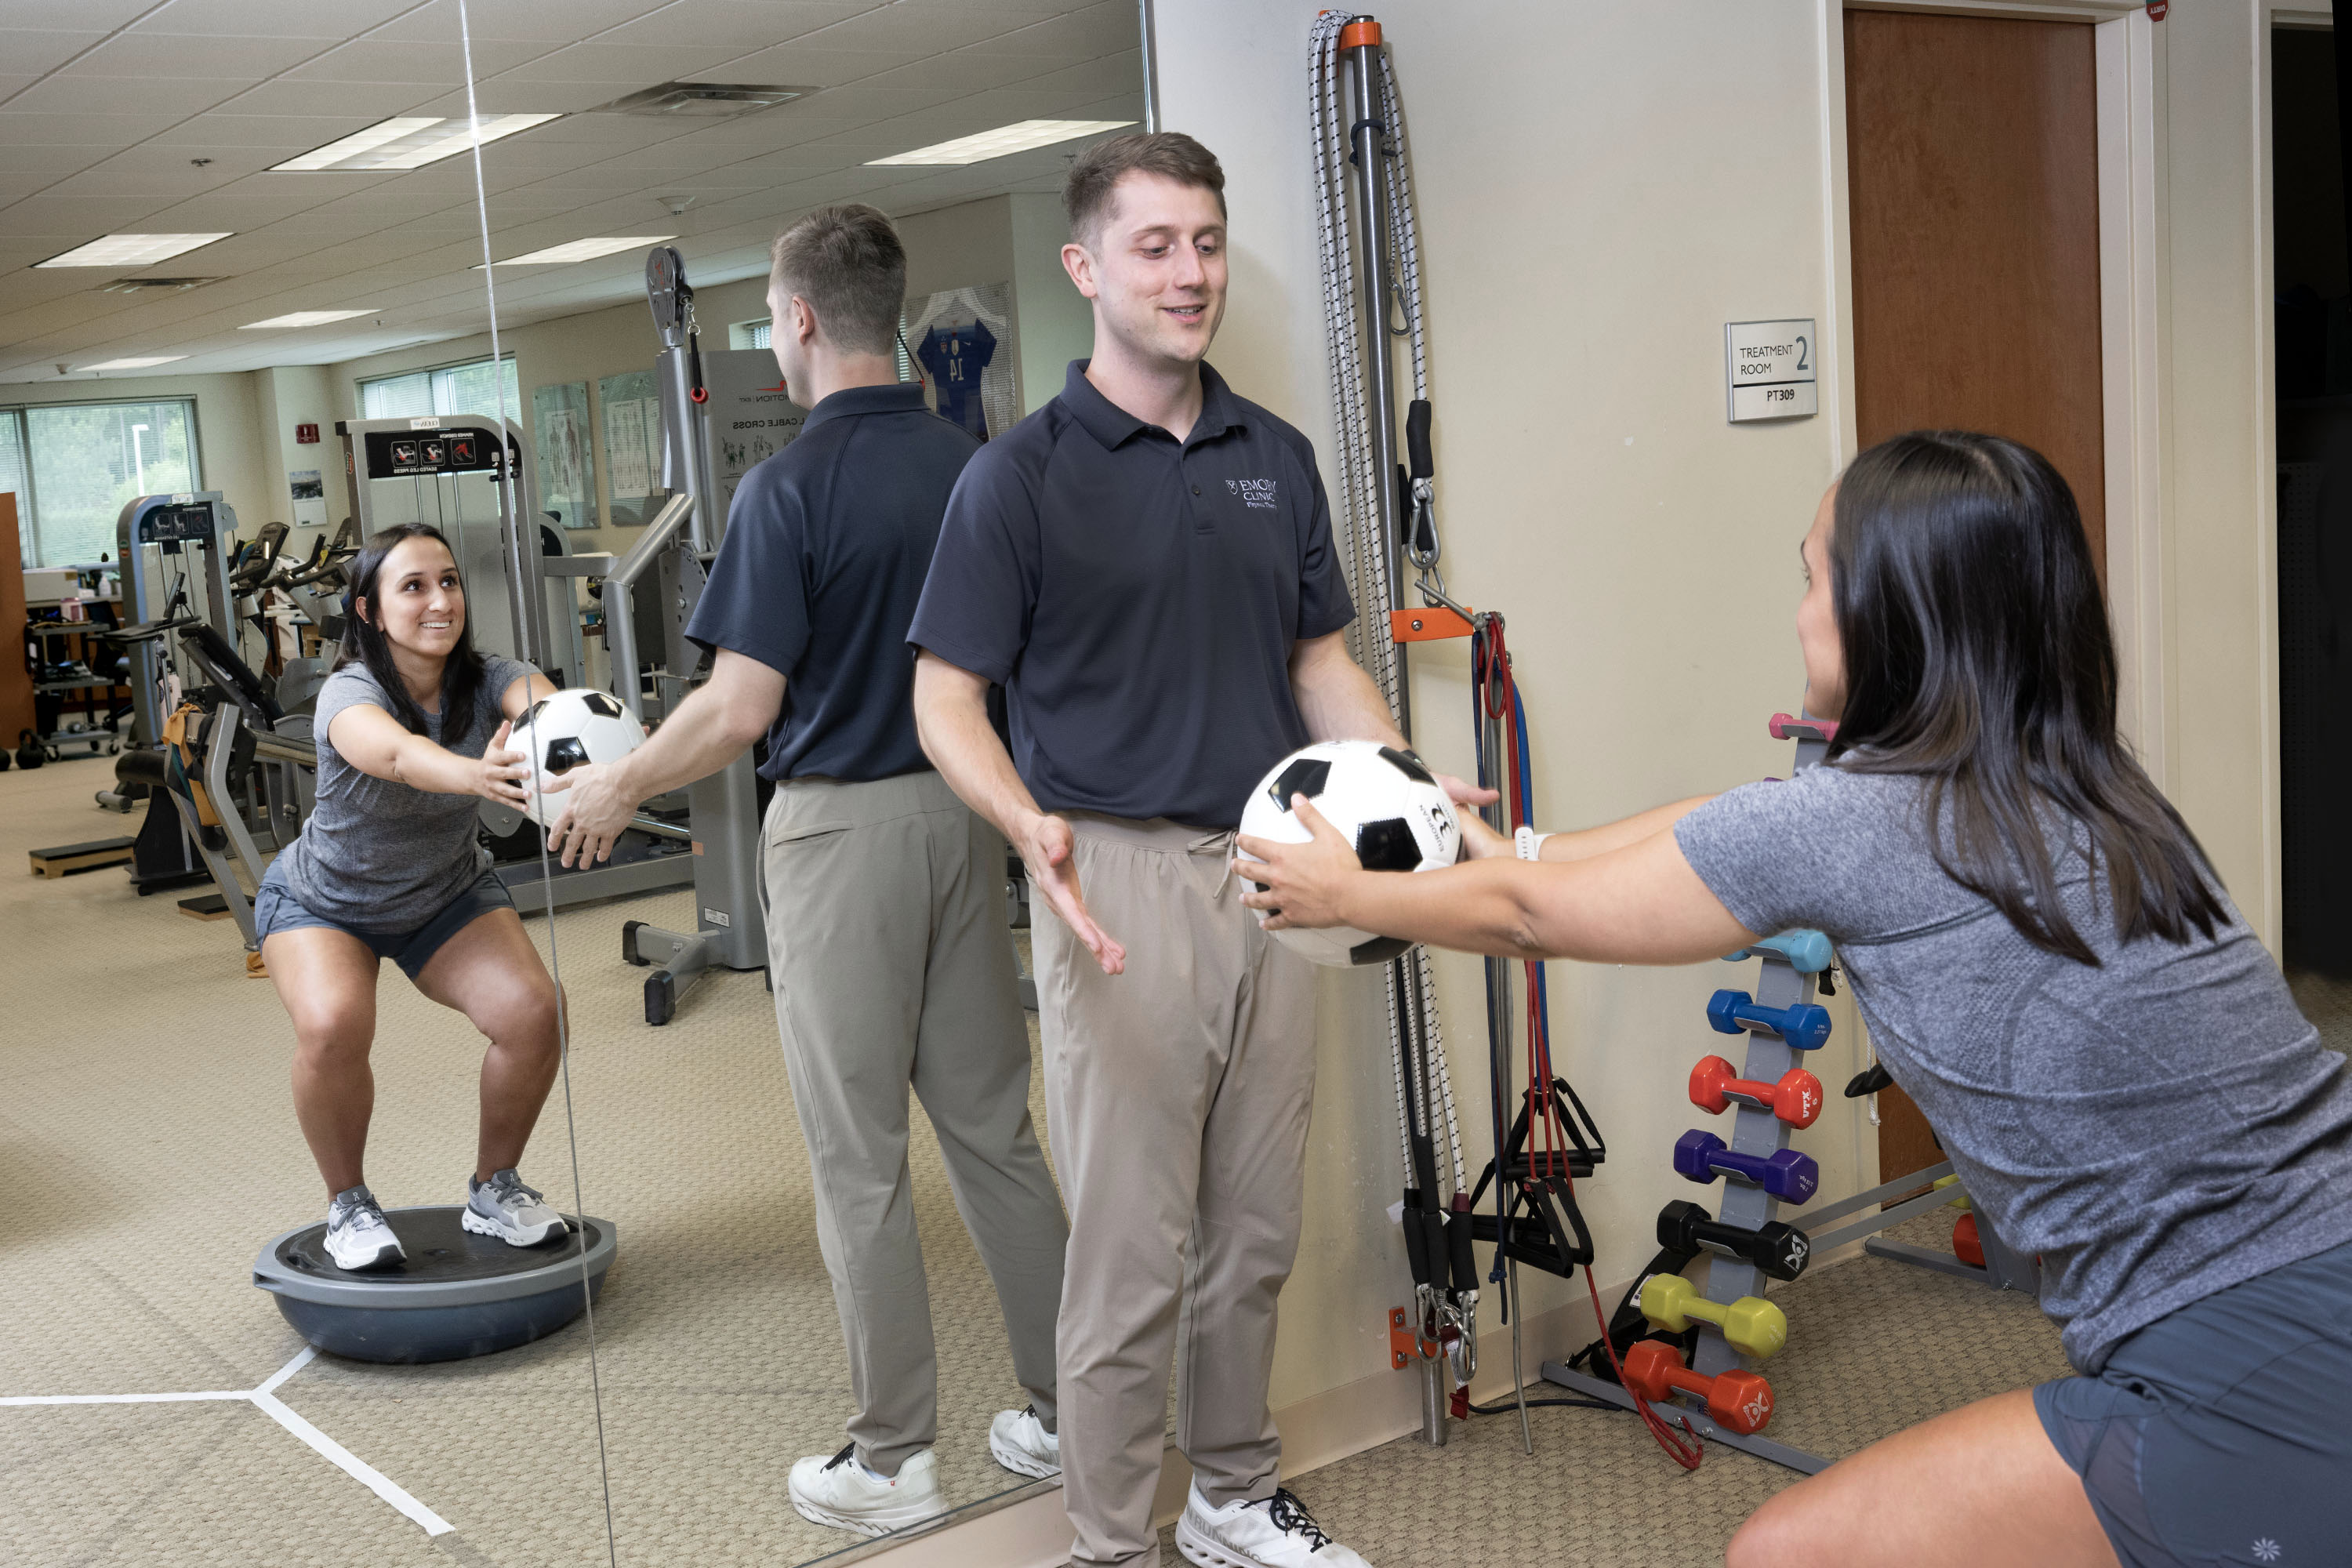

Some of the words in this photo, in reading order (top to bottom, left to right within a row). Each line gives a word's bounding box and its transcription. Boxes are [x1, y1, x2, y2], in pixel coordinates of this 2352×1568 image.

[2150, 5, 2165, 14] DIRTY
[1740, 344, 1793, 358] TREATMENT
[1795, 336, 1809, 371] 2
[1740, 363, 1772, 376] ROOM
[1767, 389, 1795, 401] PT309
[1243, 492, 1275, 502] CLINIC
[1417, 804, 1444, 852] EUROPEAN
[1802, 1091, 1810, 1119] VTX
[1186, 1504, 1194, 1521] N
